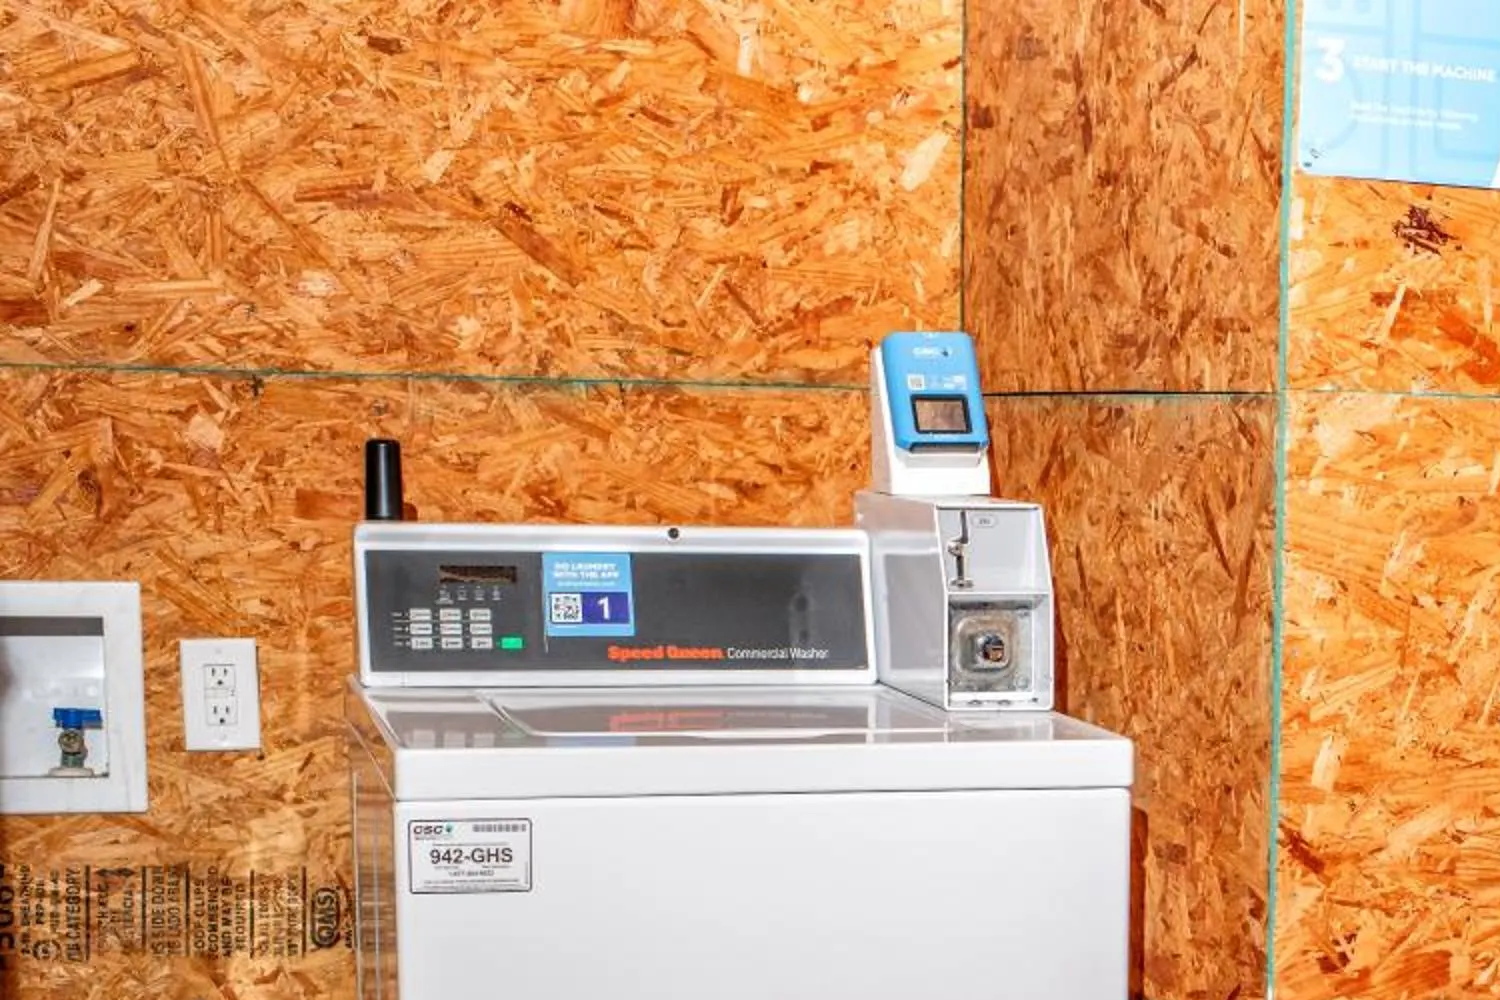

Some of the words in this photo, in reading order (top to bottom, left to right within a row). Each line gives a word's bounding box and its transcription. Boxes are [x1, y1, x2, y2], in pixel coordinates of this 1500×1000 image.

[1314, 37, 1346, 84] 3
[1352, 55, 1399, 73] START
[1401, 59, 1430, 78] THE
[1431, 62, 1498, 84] MACHINE
[597, 595, 611, 621] 1
[607, 644, 665, 662] Speed
[666, 644, 724, 660] Queen
[727, 646, 788, 660] Commercial
[790, 646, 830, 660] Washer
[429, 847, 514, 866] 942-GHS
[65, 867, 81, 939] CATEGORY
[193, 878, 205, 918] CLIPS
[221, 900, 232, 928] MAY
